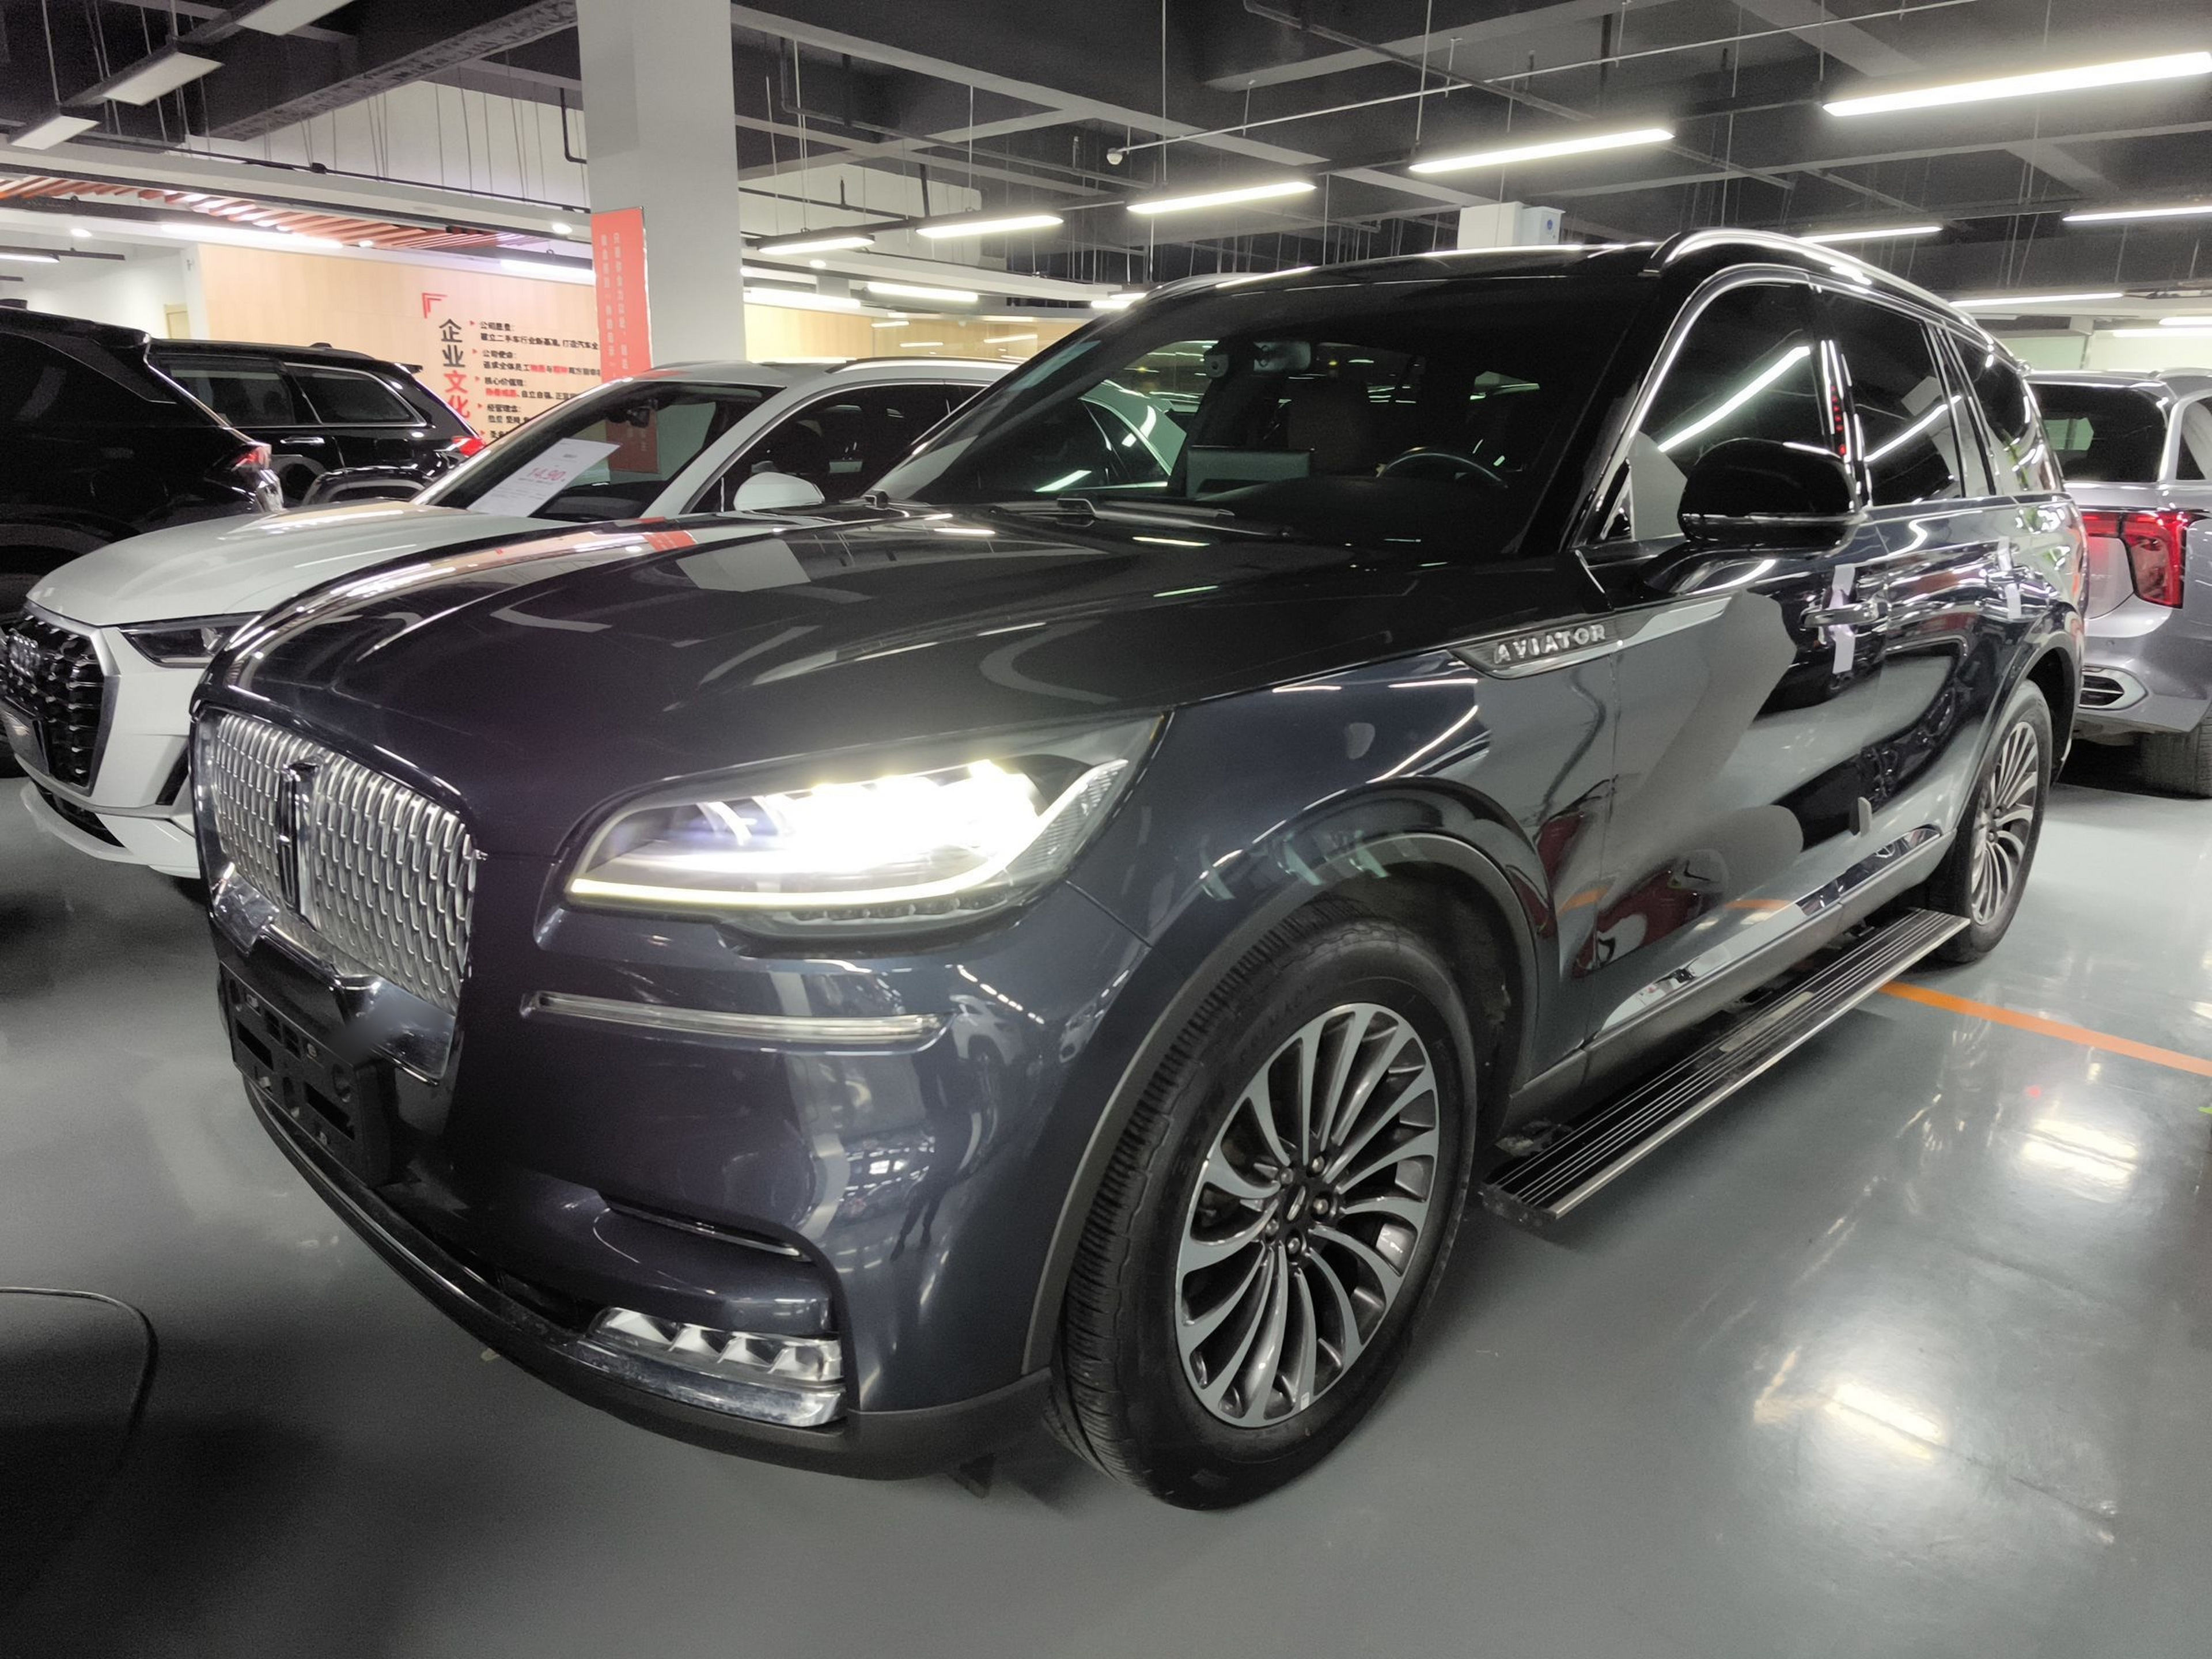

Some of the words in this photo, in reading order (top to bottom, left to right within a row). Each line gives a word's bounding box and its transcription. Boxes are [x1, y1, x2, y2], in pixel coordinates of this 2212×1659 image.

[438, 318, 471, 419] 企业文化
[1494, 624, 1605, 664] AVIATOR
